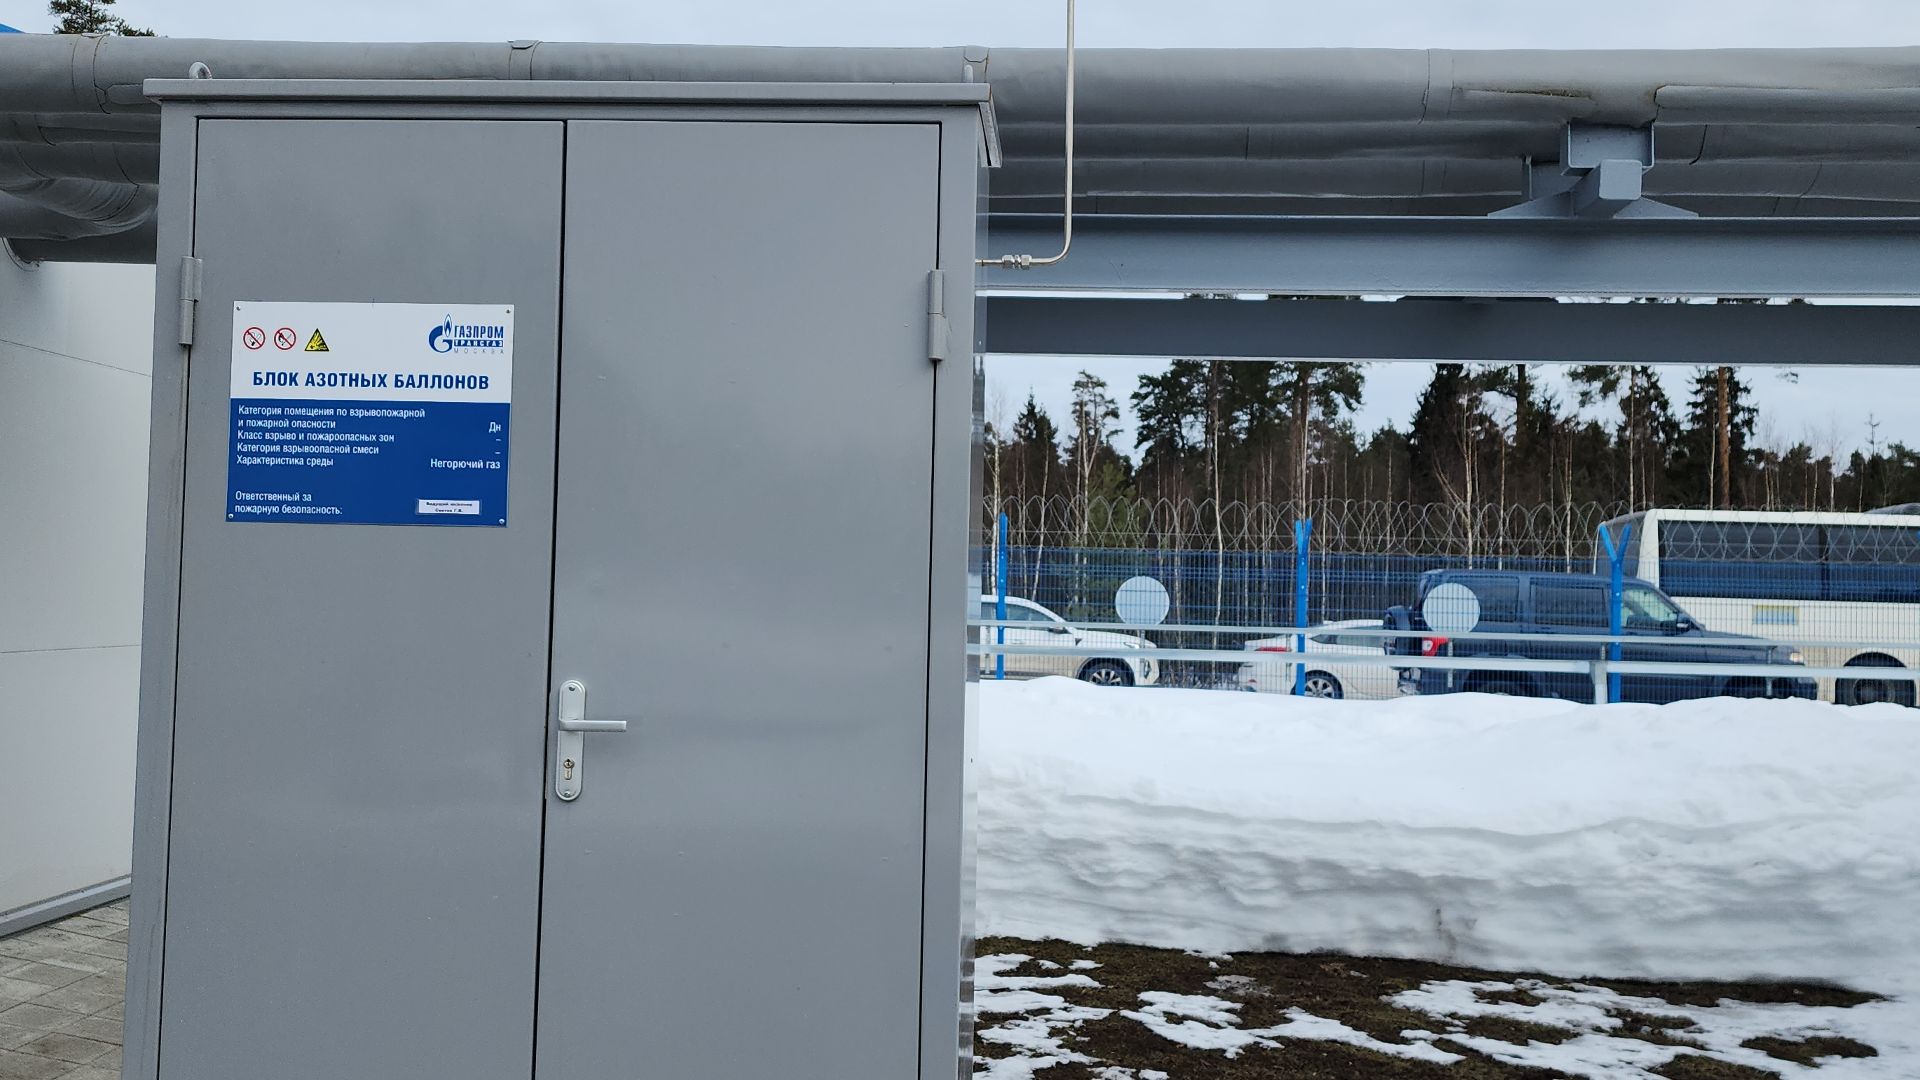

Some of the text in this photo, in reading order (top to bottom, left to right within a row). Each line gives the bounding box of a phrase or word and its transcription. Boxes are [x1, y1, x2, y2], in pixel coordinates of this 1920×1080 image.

[454, 325, 504, 339] ГАЗПРОМ
[253, 371, 489, 390] БЛОК АЗОТНЫХ БАЛЛОНОВ
[238, 405, 426, 419] Категория помещения по взрывопожарной
[246, 419, 289, 429] пожарной
[291, 420, 336, 428] опасности
[488, 421, 501, 433] Дн
[237, 430, 263, 440] Класс
[264, 432, 297, 442] взрыво
[306, 432, 377, 443] пожароопасных
[378, 433, 395, 442] зон
[237, 442, 379, 455] Категория взрывоопасной смеси
[236, 454, 334, 467] Характеристика среды
[430, 458, 501, 470] Негорючий газ
[235, 491, 312, 502] Ответственный за
[234, 504, 343, 515] пожарную безопасность:
